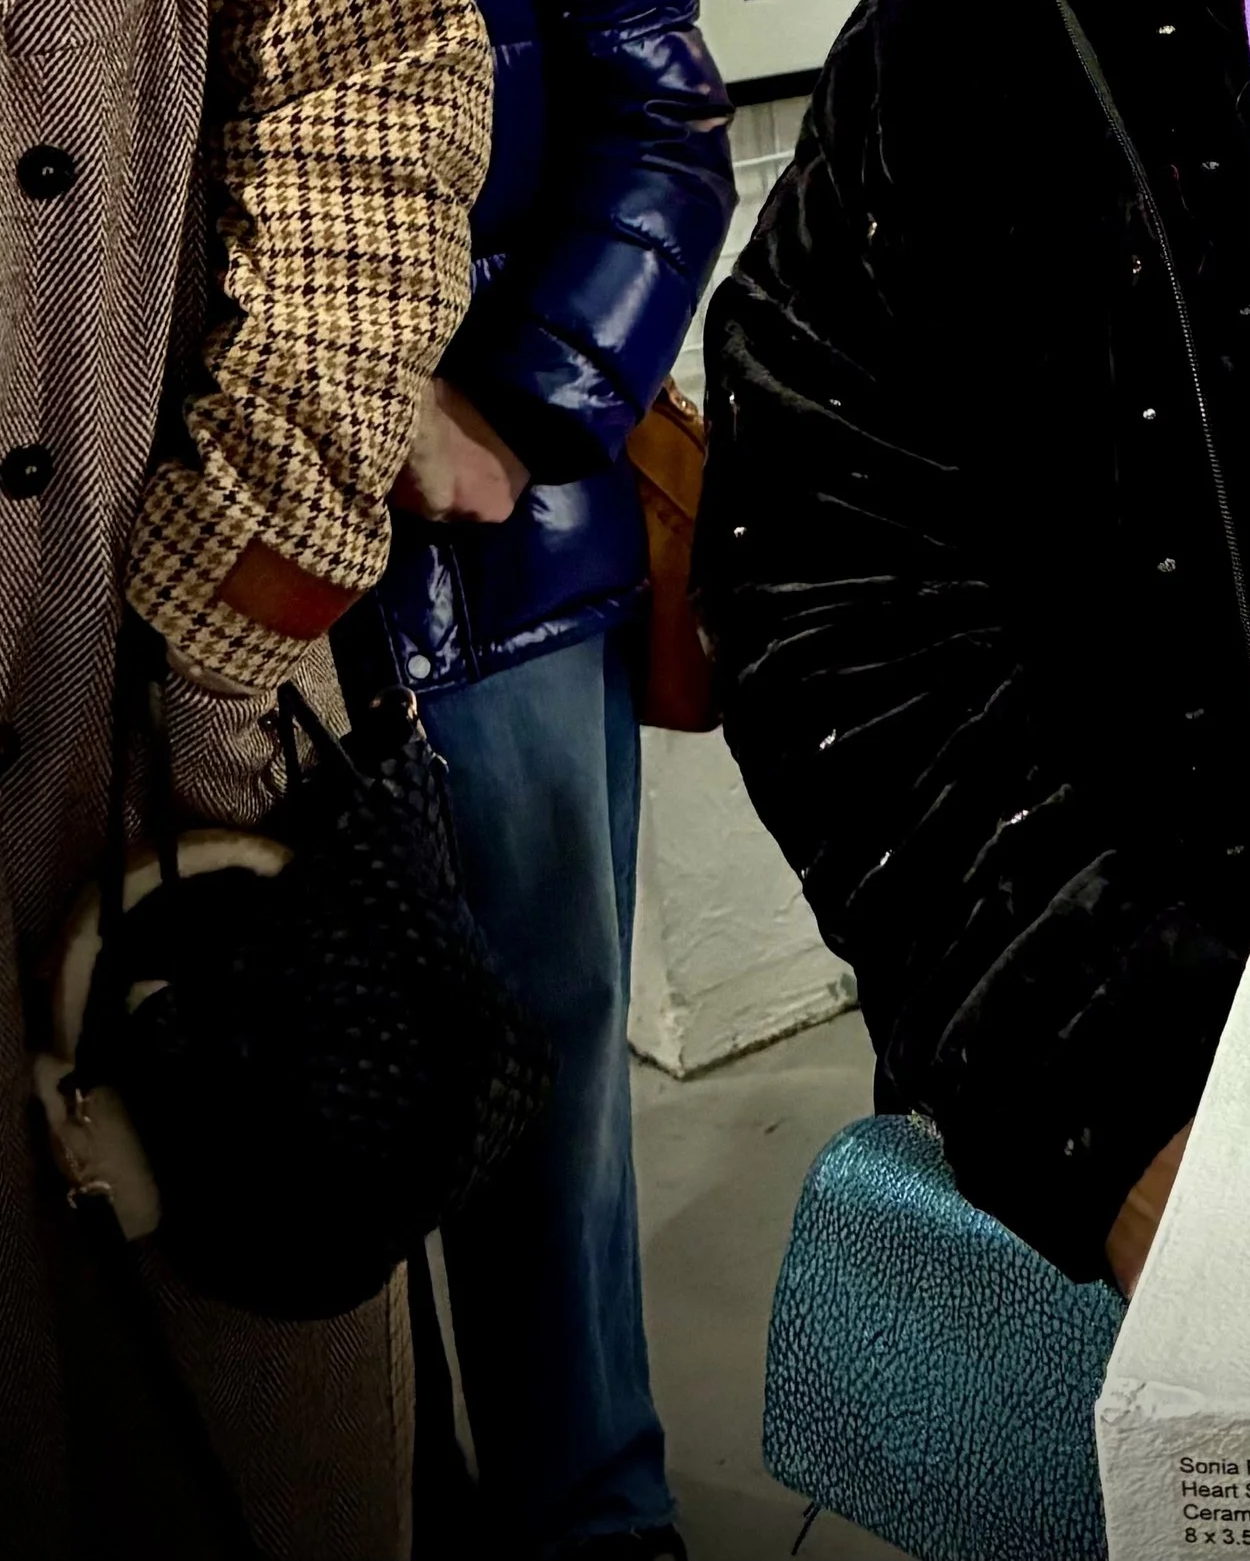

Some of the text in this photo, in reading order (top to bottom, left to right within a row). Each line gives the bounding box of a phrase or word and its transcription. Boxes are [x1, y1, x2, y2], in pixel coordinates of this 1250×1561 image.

[1179, 1456, 1240, 1475] Sonia
[1181, 1480, 1240, 1499] Heart
[1184, 1526, 1198, 1544] 8
[1203, 1530, 1217, 1545] x
